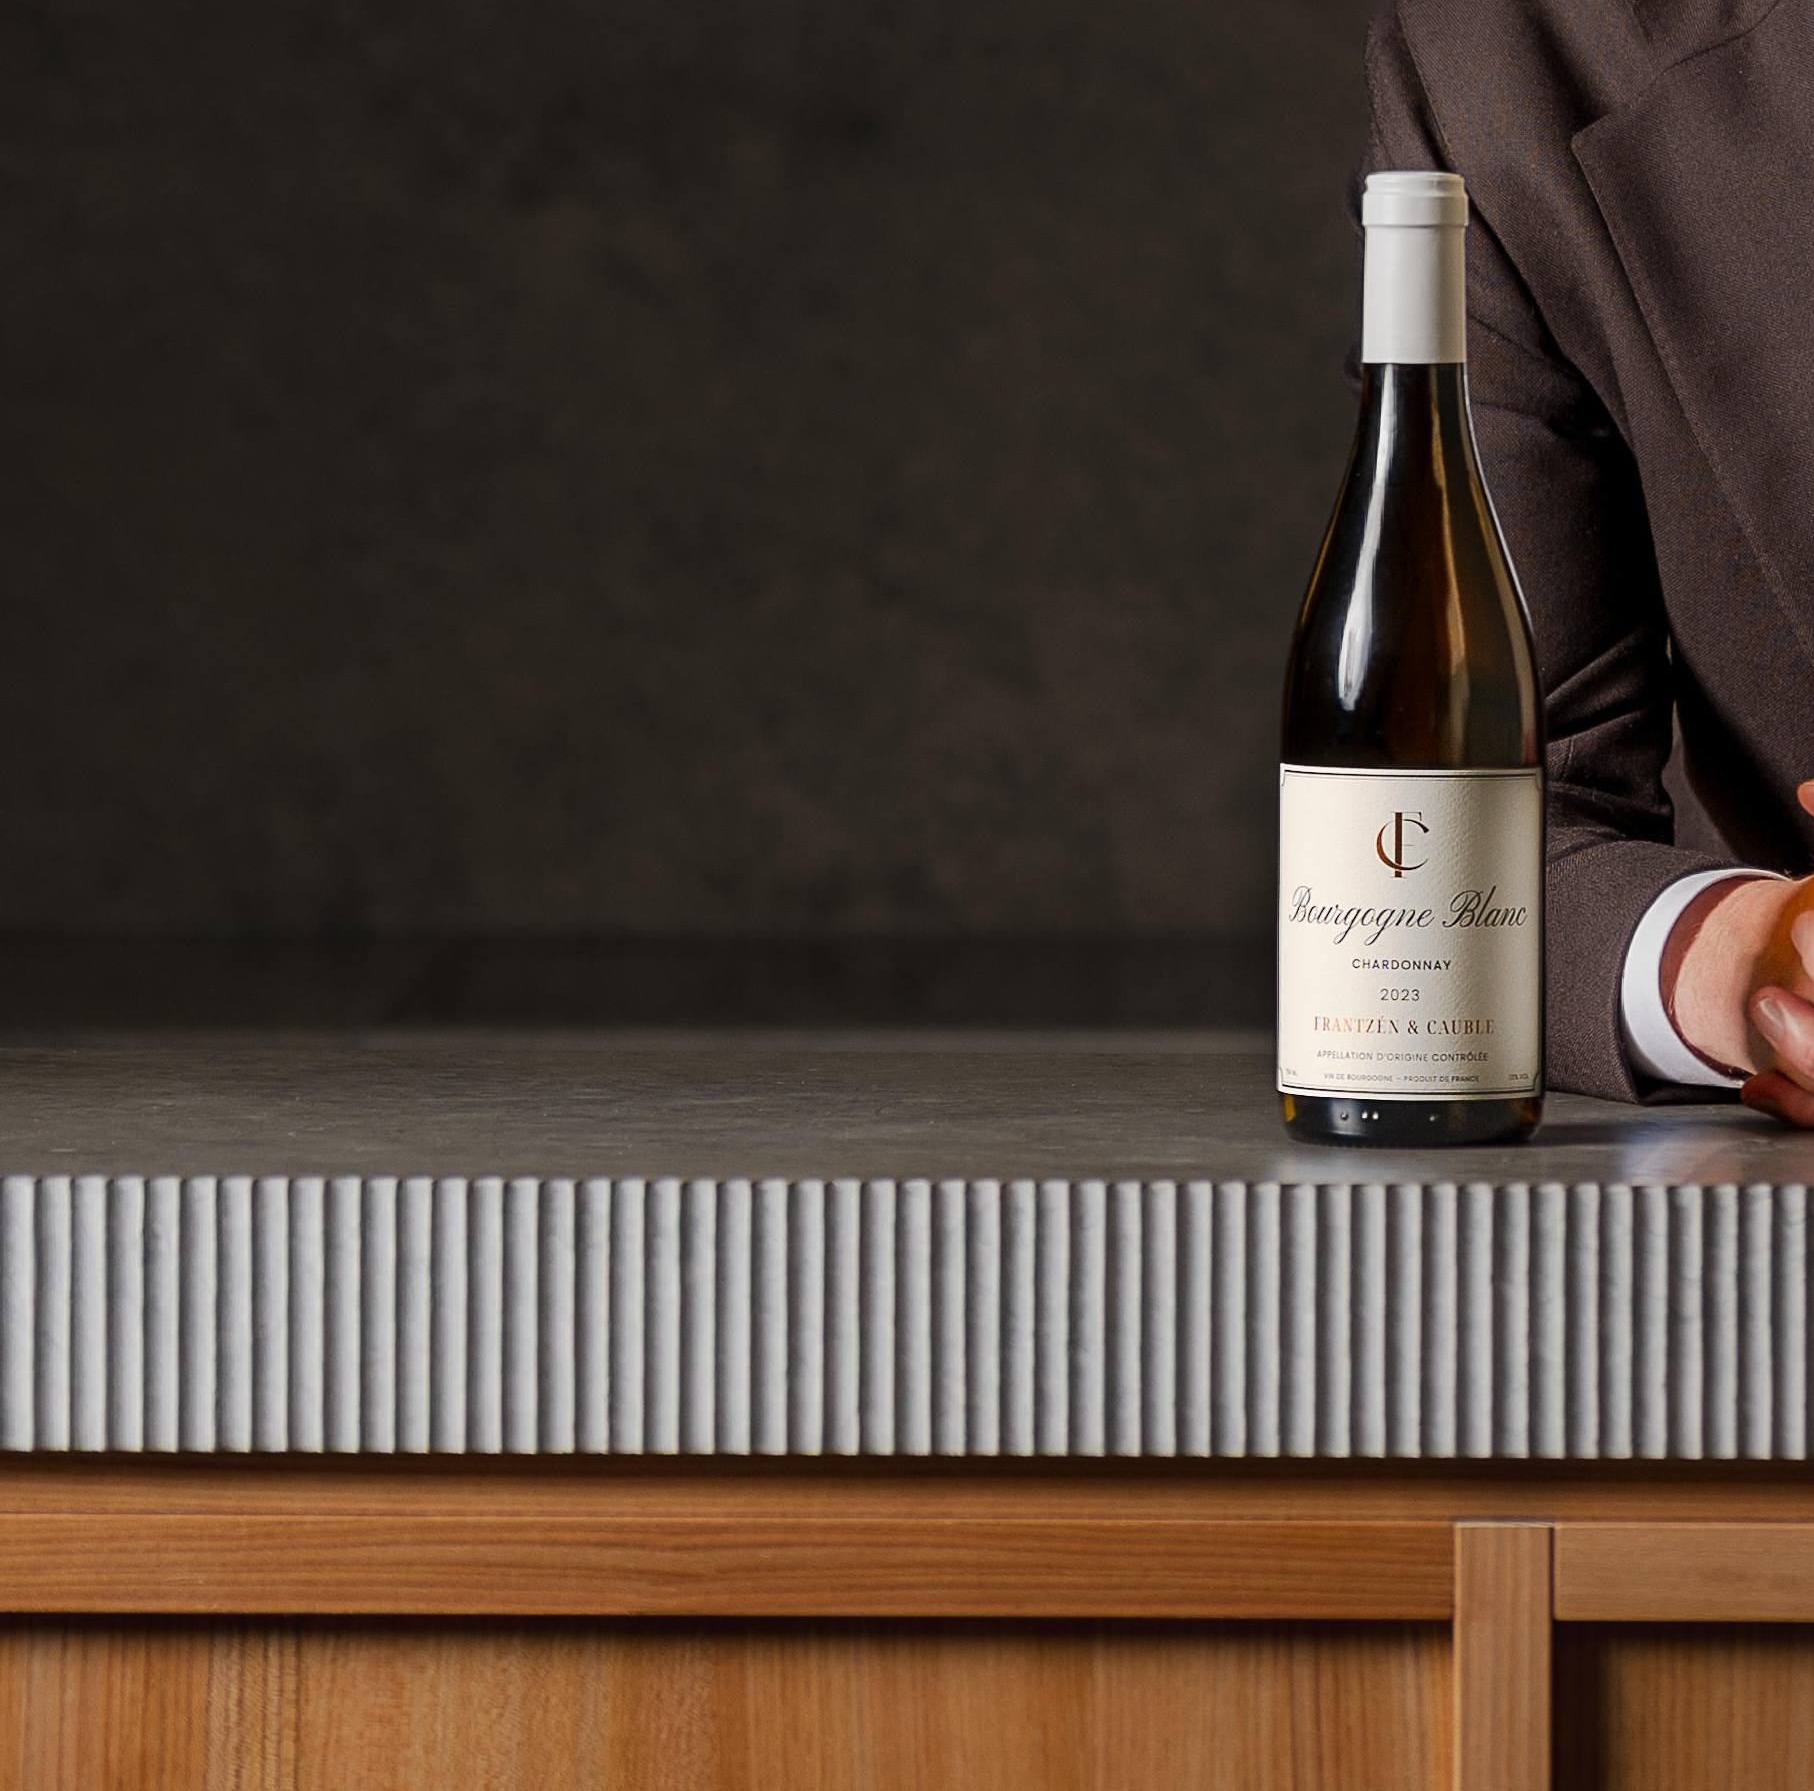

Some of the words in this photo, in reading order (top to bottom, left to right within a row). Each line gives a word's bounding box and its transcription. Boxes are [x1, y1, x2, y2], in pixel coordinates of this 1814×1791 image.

[1289, 885, 1435, 946] Bourgogne
[1443, 885, 1528, 928] Blanc
[1352, 958, 1452, 971] CHARDONNAY
[1380, 988, 1420, 1002] 2023
[1407, 1018, 1419, 1035] &
[1427, 1018, 1495, 1035] CAUBLE
[1316, 1049, 1373, 1061] APPELLATION
[1376, 1051, 1429, 1062] D'ORIGINE
